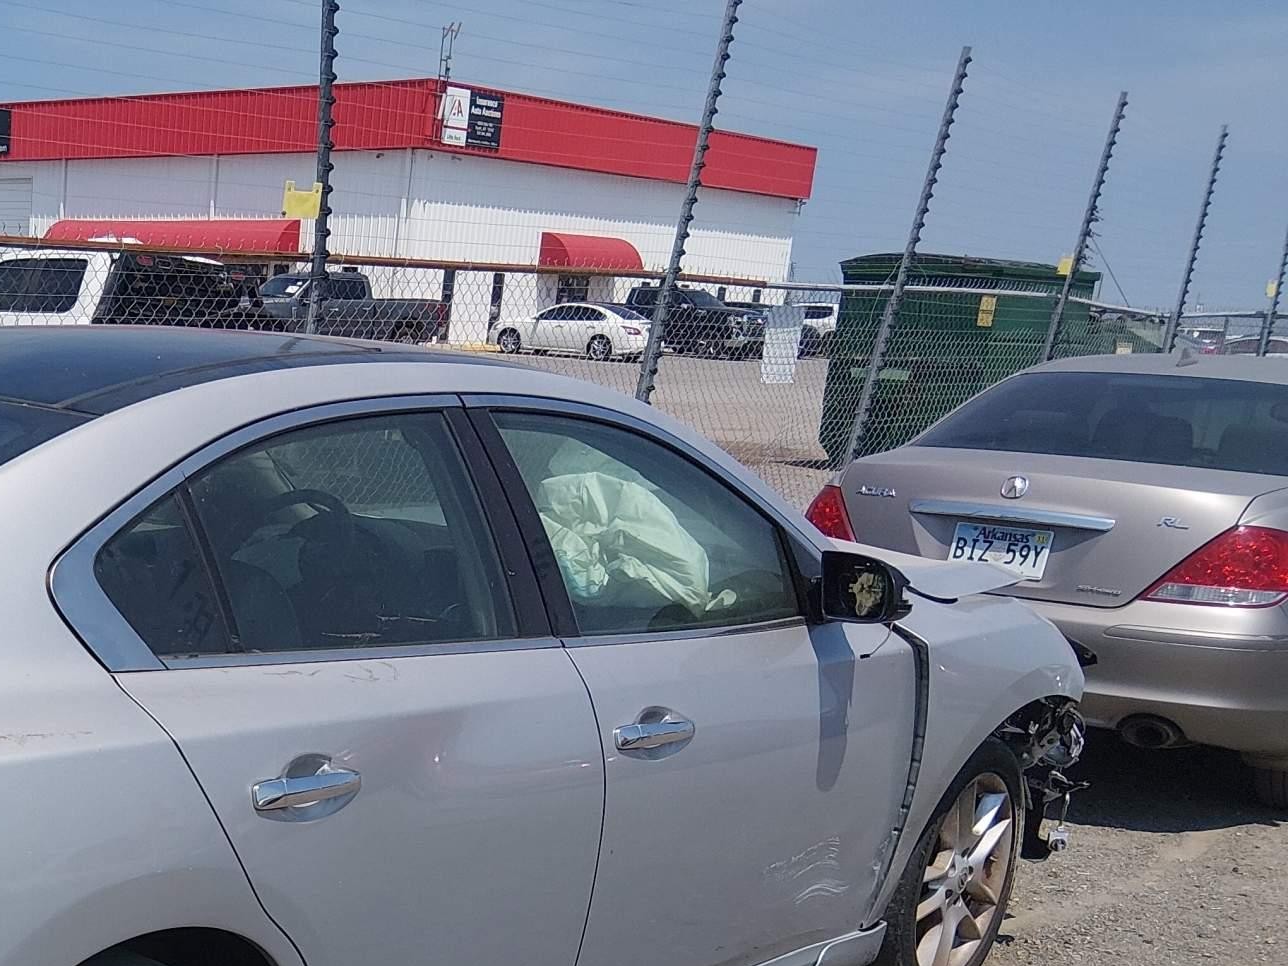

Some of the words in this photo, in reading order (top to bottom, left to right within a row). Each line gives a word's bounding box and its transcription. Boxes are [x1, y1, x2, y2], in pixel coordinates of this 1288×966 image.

[976, 525, 1032, 544] Arkansas
[952, 536, 994, 562] BIZ
[1003, 542, 1046, 568] 59Y
